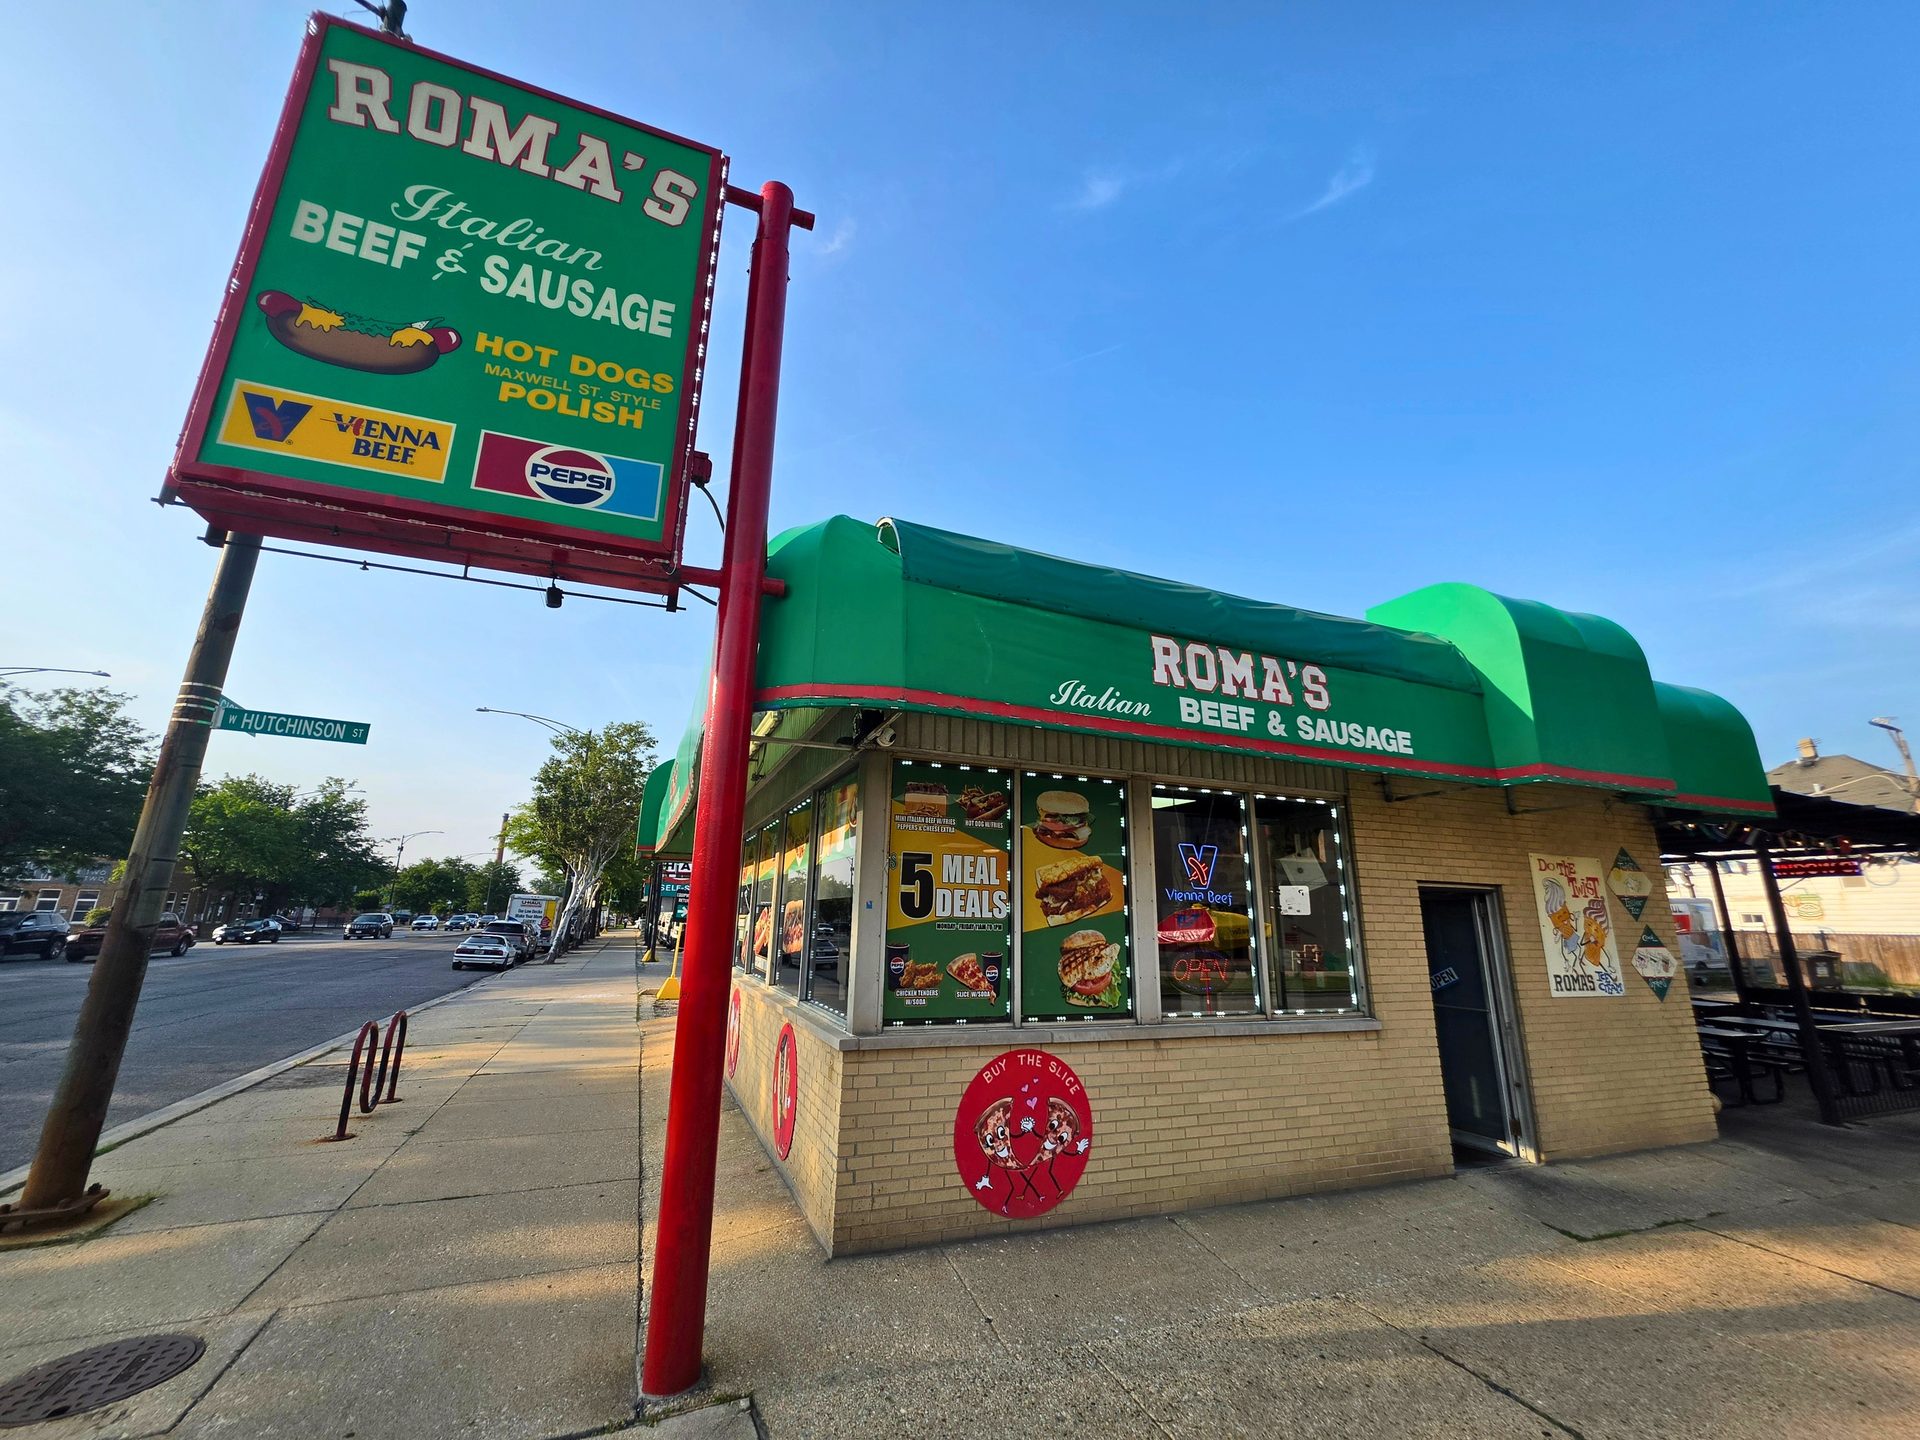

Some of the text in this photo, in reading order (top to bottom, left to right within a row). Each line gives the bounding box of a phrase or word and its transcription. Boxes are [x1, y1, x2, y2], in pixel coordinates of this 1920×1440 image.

[326, 57, 698, 228] ROMA'S
[391, 184, 603, 271] Italian
[290, 199, 676, 337] BEEF & SAUSAGE
[475, 331, 674, 394] HOT DOGS
[484, 363, 662, 410] MAXWELL ST. STYLE
[498, 381, 644, 429] POLISH
[332, 412, 441, 450] VIENNA
[352, 438, 417, 465] BEEF
[530, 462, 611, 491] PEPSI
[1150, 634, 1331, 712] ROMA'S
[228, 713, 364, 740] W HUTCHINSON ST
[1050, 680, 1414, 755] Italian BEEF & SAUSAGE
[897, 823, 918, 831] PEPPERS
[942, 854, 999, 885] MEAL
[1537, 858, 1555, 871] Do
[935, 889, 1008, 919] DEALS
[1165, 888, 1233, 906] Vienna Beef
[1173, 958, 1229, 982] OPEN
[982, 1054, 1080, 1095] BUY THE SLICE
